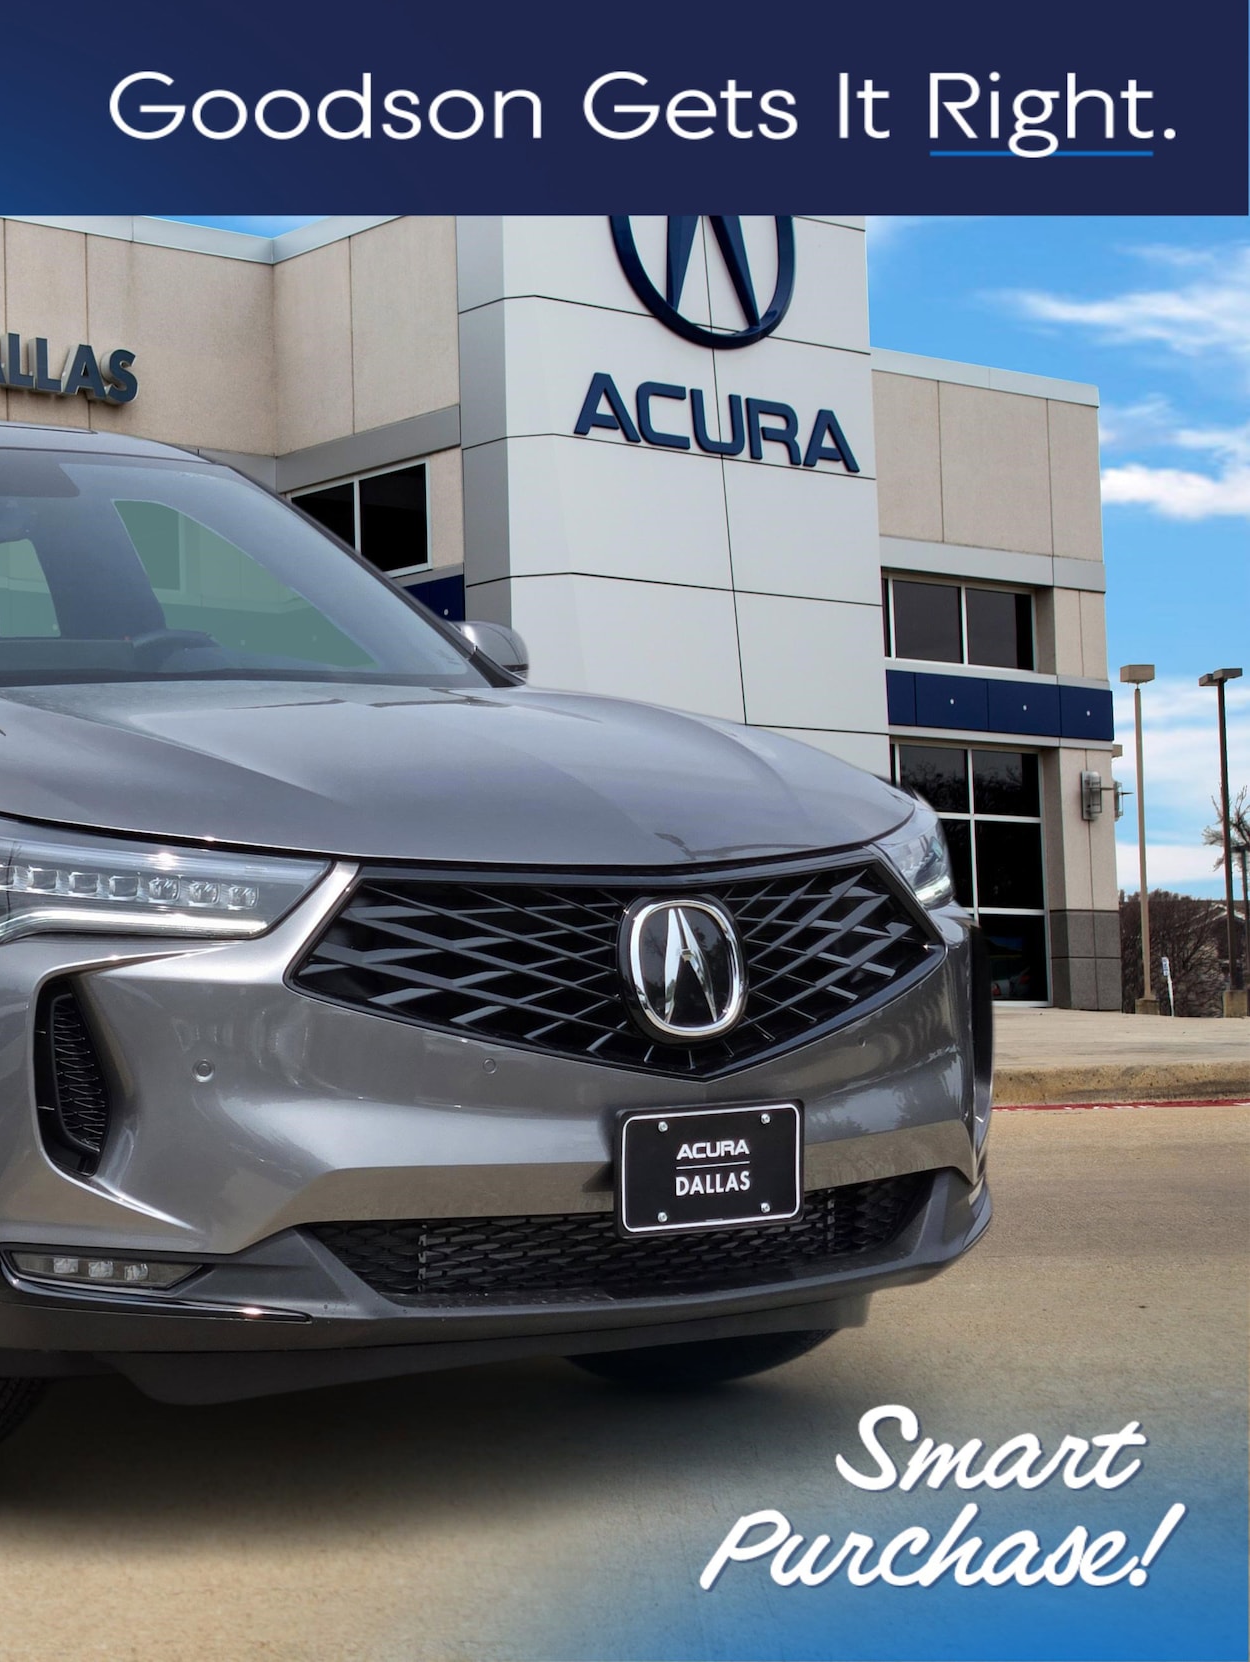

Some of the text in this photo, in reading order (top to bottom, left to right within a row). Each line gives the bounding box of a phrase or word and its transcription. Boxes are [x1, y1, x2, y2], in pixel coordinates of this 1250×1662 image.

[573, 371, 861, 473] ACURA
[675, 1138, 751, 1161] ACURA
[675, 1170, 752, 1197] DALLAS
